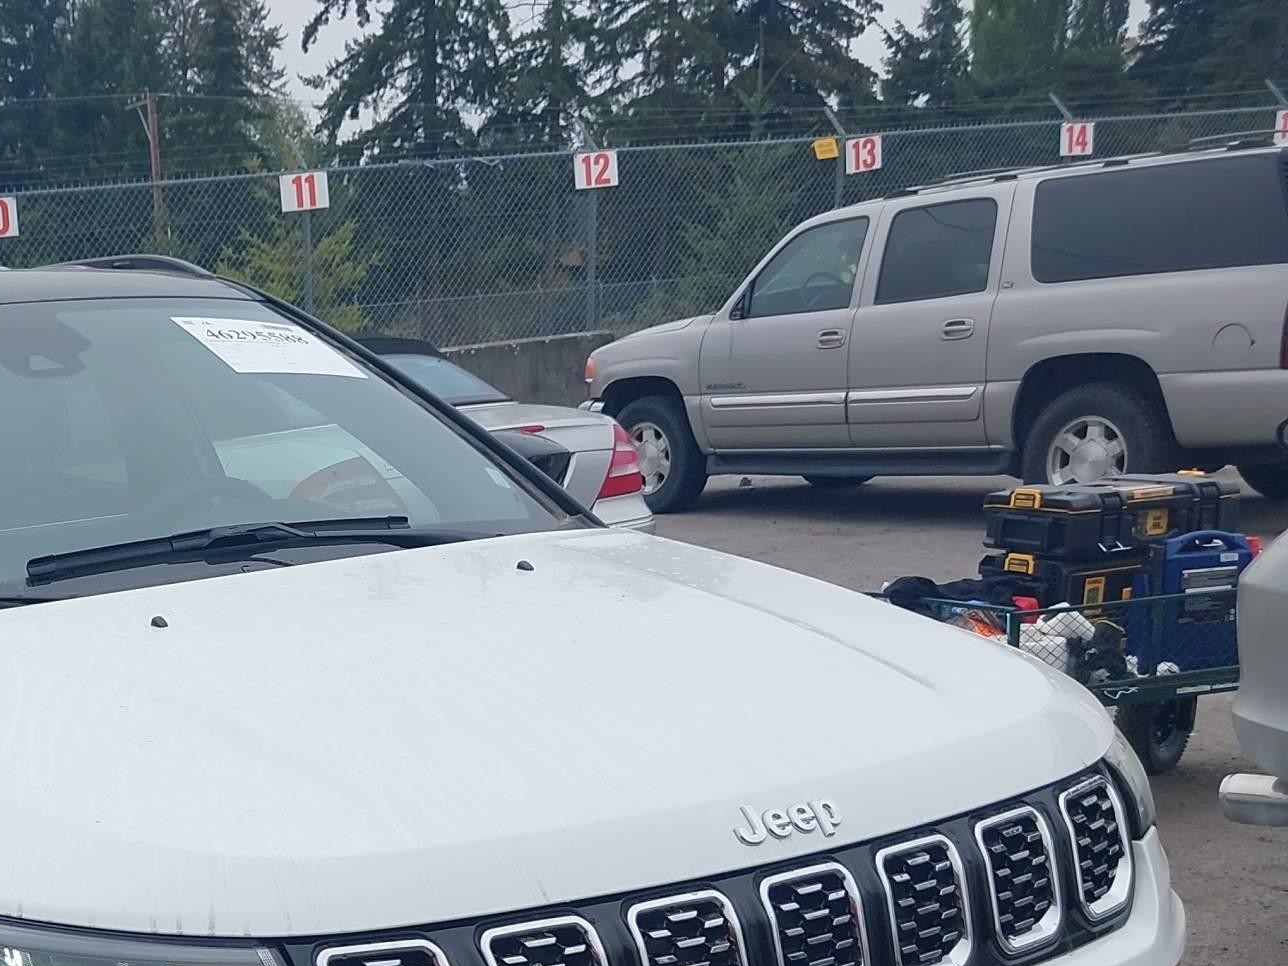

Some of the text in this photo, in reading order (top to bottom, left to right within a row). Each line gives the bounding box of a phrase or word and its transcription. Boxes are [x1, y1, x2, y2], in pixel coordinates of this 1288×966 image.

[852, 138, 876, 171] 13
[1066, 125, 1087, 154] 14
[582, 153, 611, 186] 12
[292, 174, 317, 208] 11
[206, 328, 310, 345] 46295588
[732, 800, 841, 847] Jeep
